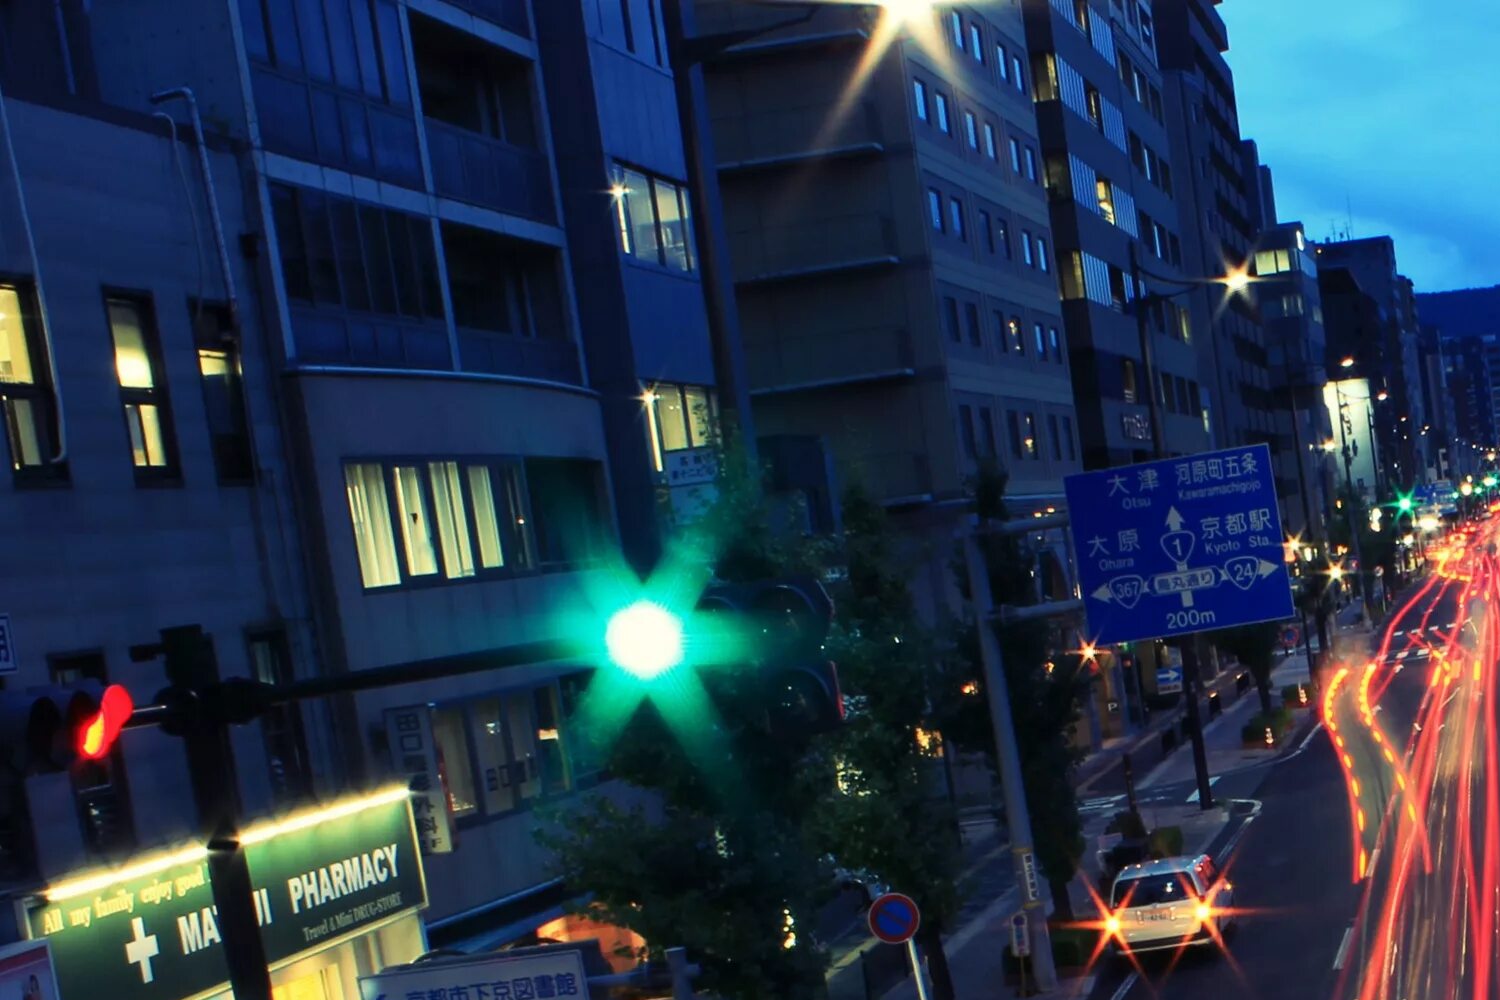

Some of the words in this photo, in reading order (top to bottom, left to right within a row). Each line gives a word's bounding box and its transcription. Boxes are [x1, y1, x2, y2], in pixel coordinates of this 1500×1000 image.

[1174, 452, 1259, 487] 河原町五条
[1107, 468, 1160, 497] 大津
[1177, 480, 1262, 501] Kawaramachigojo
[1121, 497, 1151, 511] Otsu
[1200, 507, 1273, 540] 京都駅
[1087, 528, 1141, 558] 大原
[1172, 538, 1183, 556] 1
[1205, 540, 1241, 556] Kyoto
[1099, 557, 1135, 572] Ohara
[1234, 564, 1253, 582] 24
[1116, 584, 1140, 599] 367
[1166, 609, 1216, 630] 200m
[287, 843, 400, 914] PHARMACY
[44, 908, 65, 935] All
[69, 906, 92, 928] my
[94, 889, 134, 919] family
[140, 879, 174, 905] enjoy
[302, 922, 329, 942] Travel
